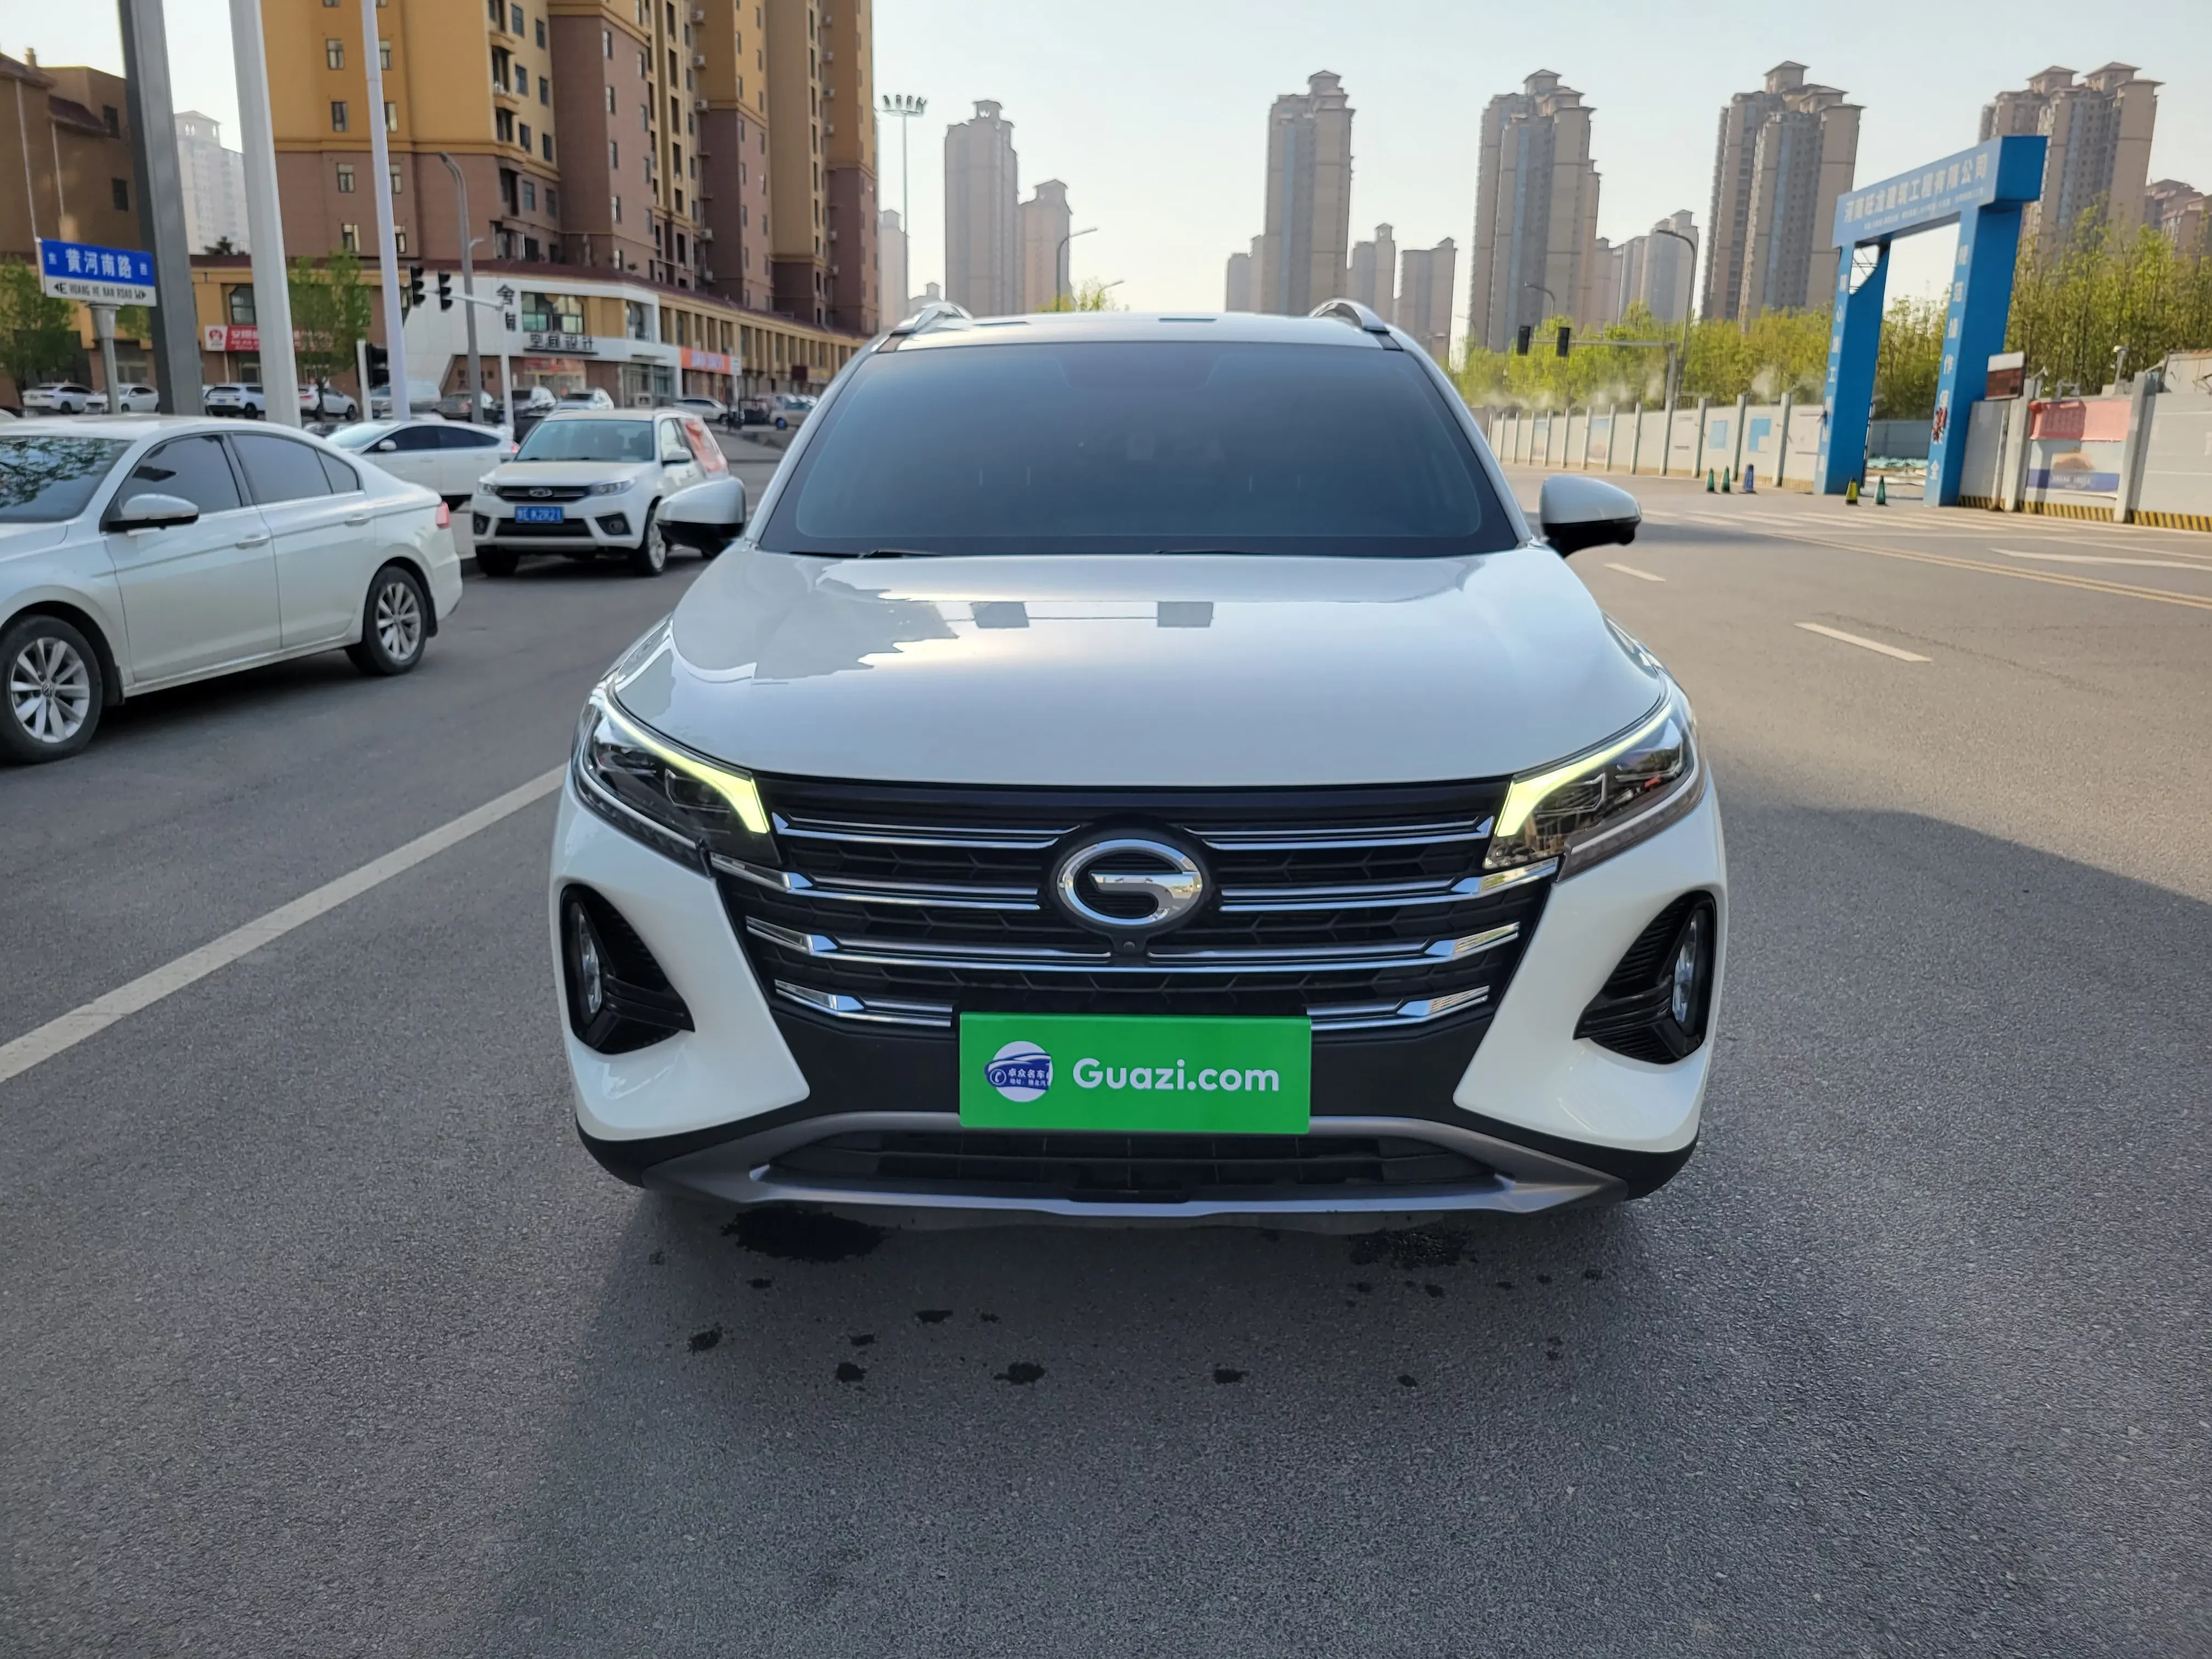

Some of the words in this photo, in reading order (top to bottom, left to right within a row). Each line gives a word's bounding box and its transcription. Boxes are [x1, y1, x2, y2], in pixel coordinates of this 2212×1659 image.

[65, 247, 132, 279] 黄河南路
[69, 284, 90, 297] HUANG
[103, 287, 115, 298] NAN
[117, 287, 132, 300] ROAD
[1008, 1067, 1046, 1079] 卓众名车
[1073, 1057, 1280, 1092] Guazi.com
